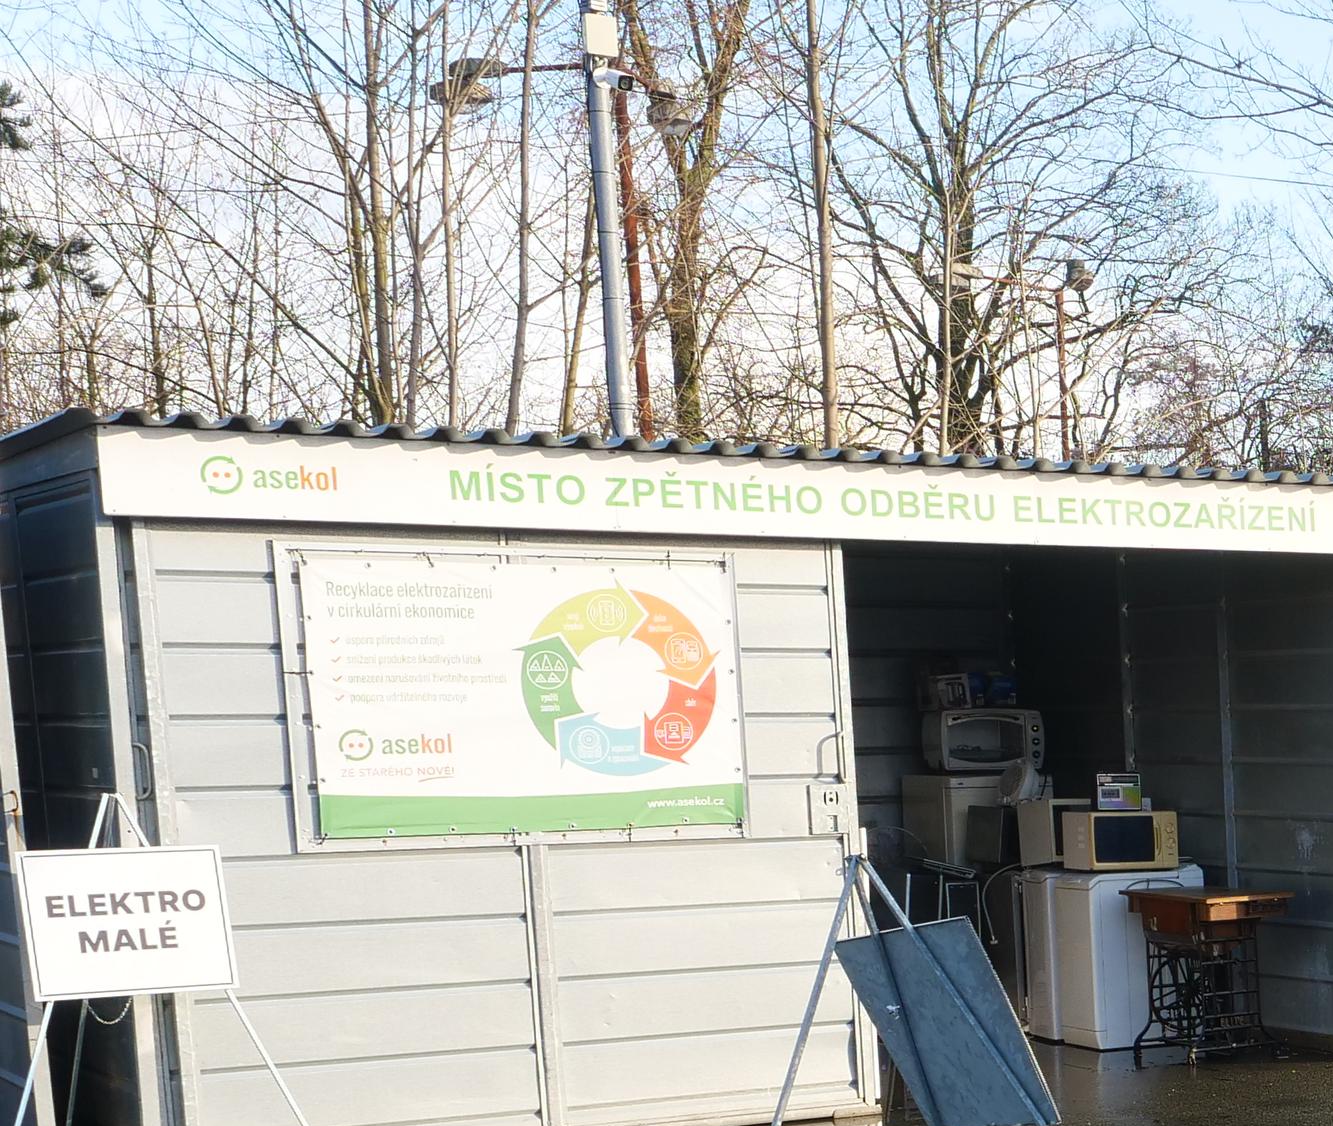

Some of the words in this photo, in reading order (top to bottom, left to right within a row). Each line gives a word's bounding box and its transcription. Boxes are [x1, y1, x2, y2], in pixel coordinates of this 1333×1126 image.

[252, 465, 338, 493] asekol
[449, 464, 586, 505] MÍSTO
[605, 471, 823, 514] ZPĚTNÉHO
[841, 484, 996, 522] ODBĚRU
[1014, 495, 1317, 533] ELEKTROZAŘÍZENÍ
[325, 581, 394, 599] Recyklace
[327, 605, 335, 618] v
[338, 603, 401, 618] cirkulární
[404, 604, 475, 619] ekonomice
[382, 733, 452, 754] asekol
[341, 768, 355, 778] ZE
[359, 767, 413, 777] STARÉHO
[647, 796, 725, 808] www.asekol.cz
[45, 889, 206, 918] ELEKTRO
[78, 920, 179, 954] MALÉ
